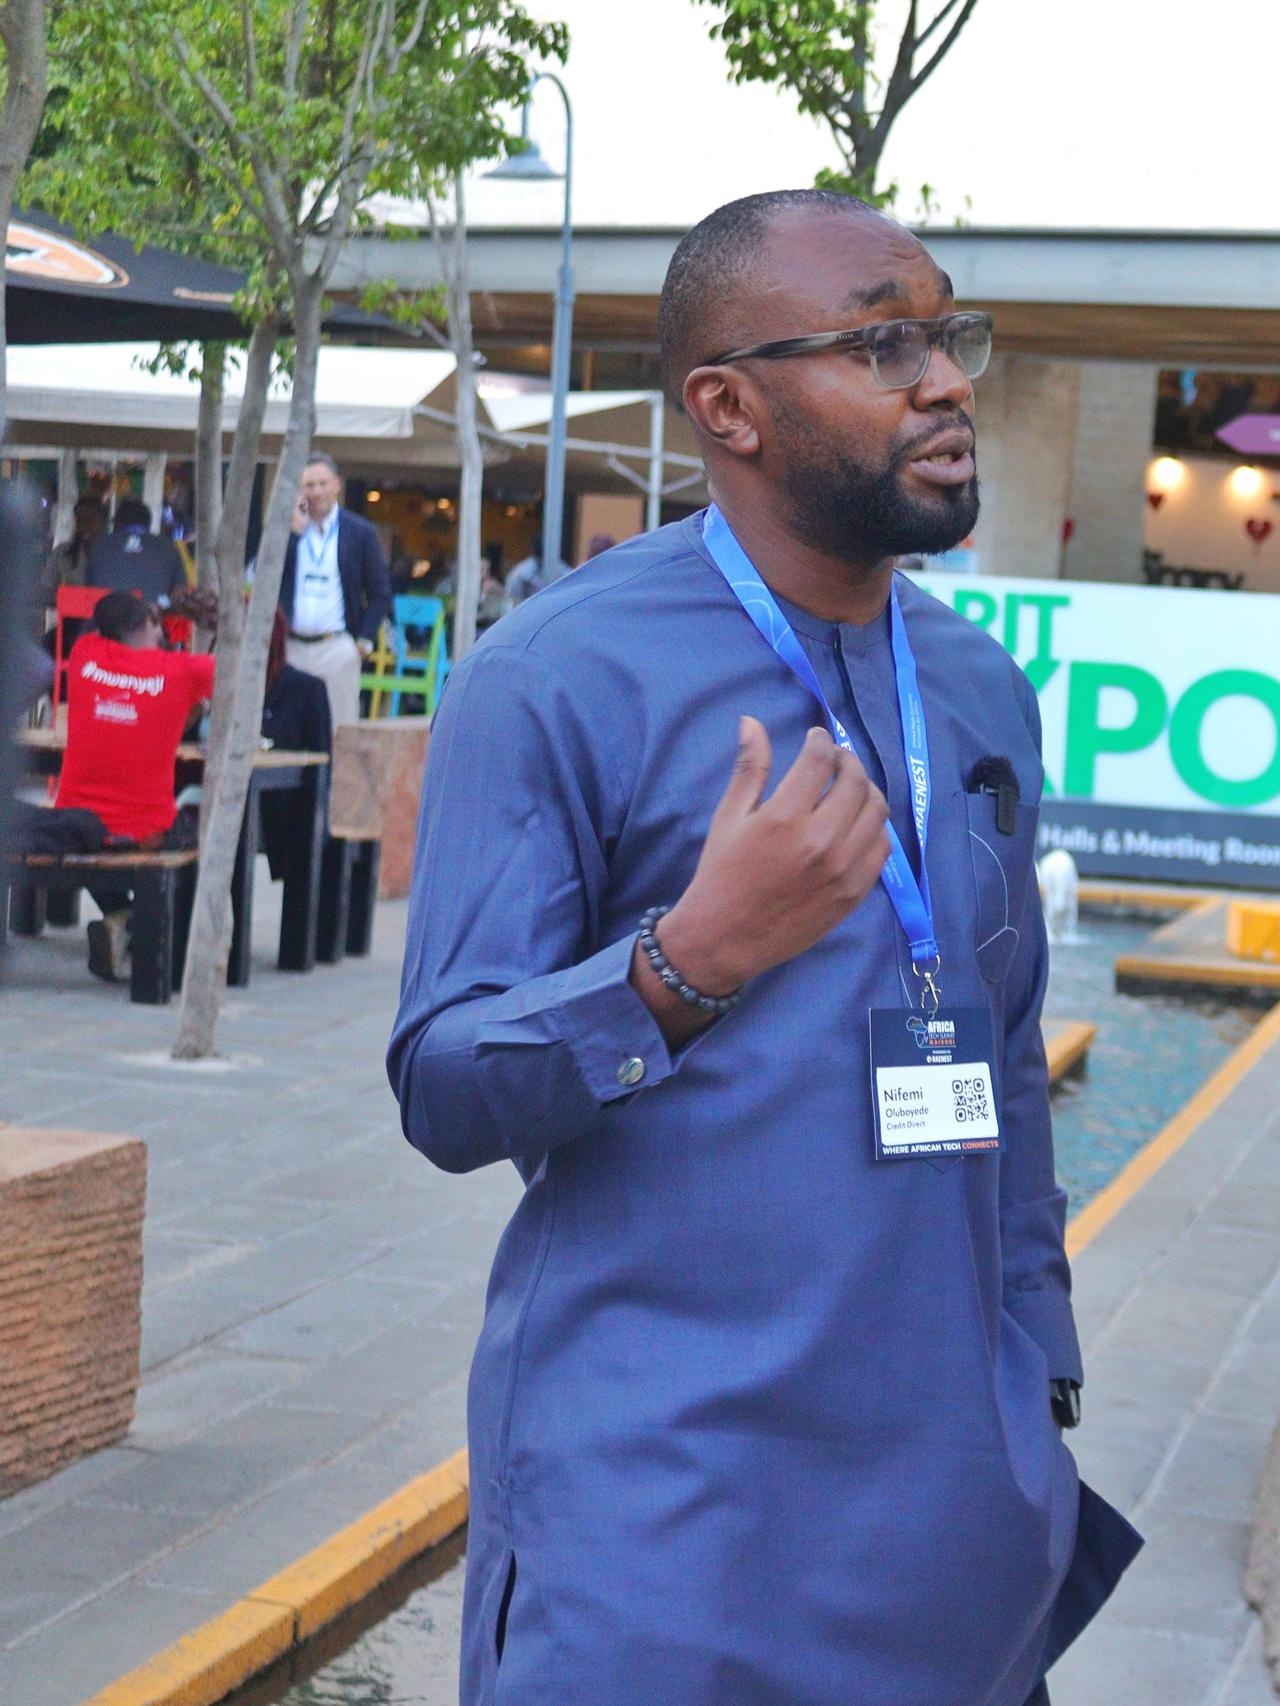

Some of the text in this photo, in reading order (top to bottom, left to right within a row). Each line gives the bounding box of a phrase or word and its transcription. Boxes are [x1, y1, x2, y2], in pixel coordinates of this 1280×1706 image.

[909, 755, 928, 830] RAENEST
[1040, 823, 1097, 854] Halls
[1102, 829, 1121, 855] &
[1123, 829, 1221, 867] Meeting
[928, 1021, 955, 1033] AFRICA
[884, 1087, 923, 1102] Nifemi
[886, 1106, 929, 1118] Oluboyede
[887, 1120, 926, 1130] Credit Direct
[883, 1140, 999, 1155] WHERE AFRICAN TECH CONNECTS
